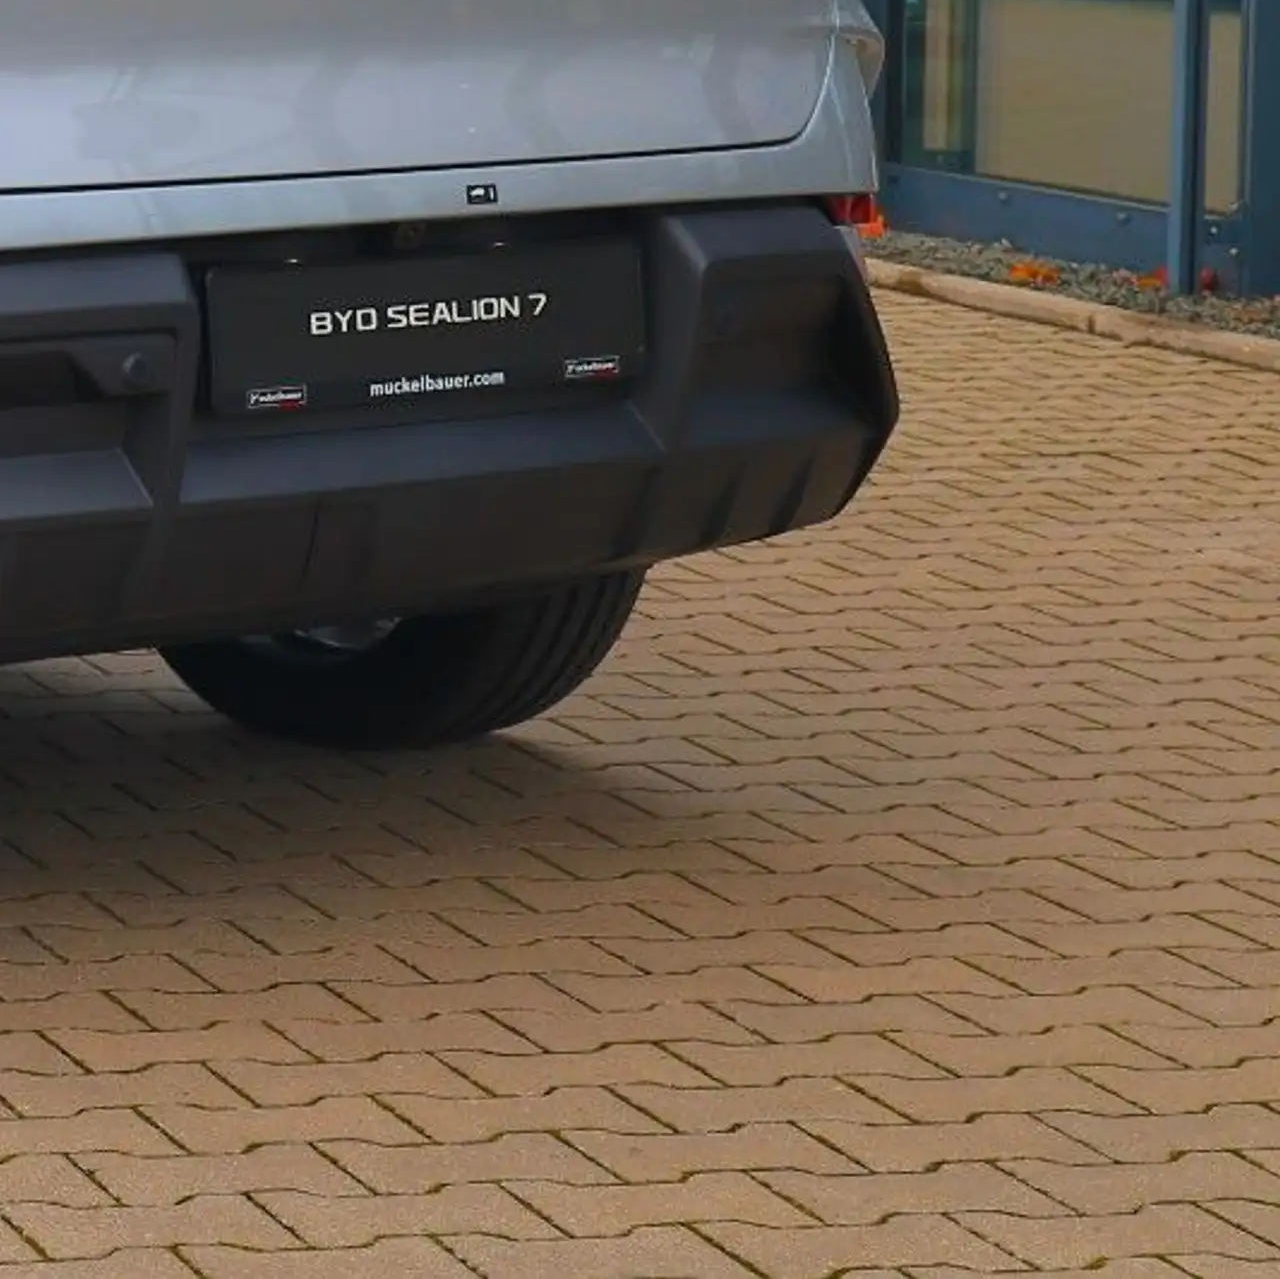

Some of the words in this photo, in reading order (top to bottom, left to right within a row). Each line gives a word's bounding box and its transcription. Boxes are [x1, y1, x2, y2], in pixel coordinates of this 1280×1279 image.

[310, 307, 378, 336] BYD
[386, 295, 521, 329] SEALION
[528, 293, 548, 316] 7
[369, 371, 505, 397] muckelbauer.com
